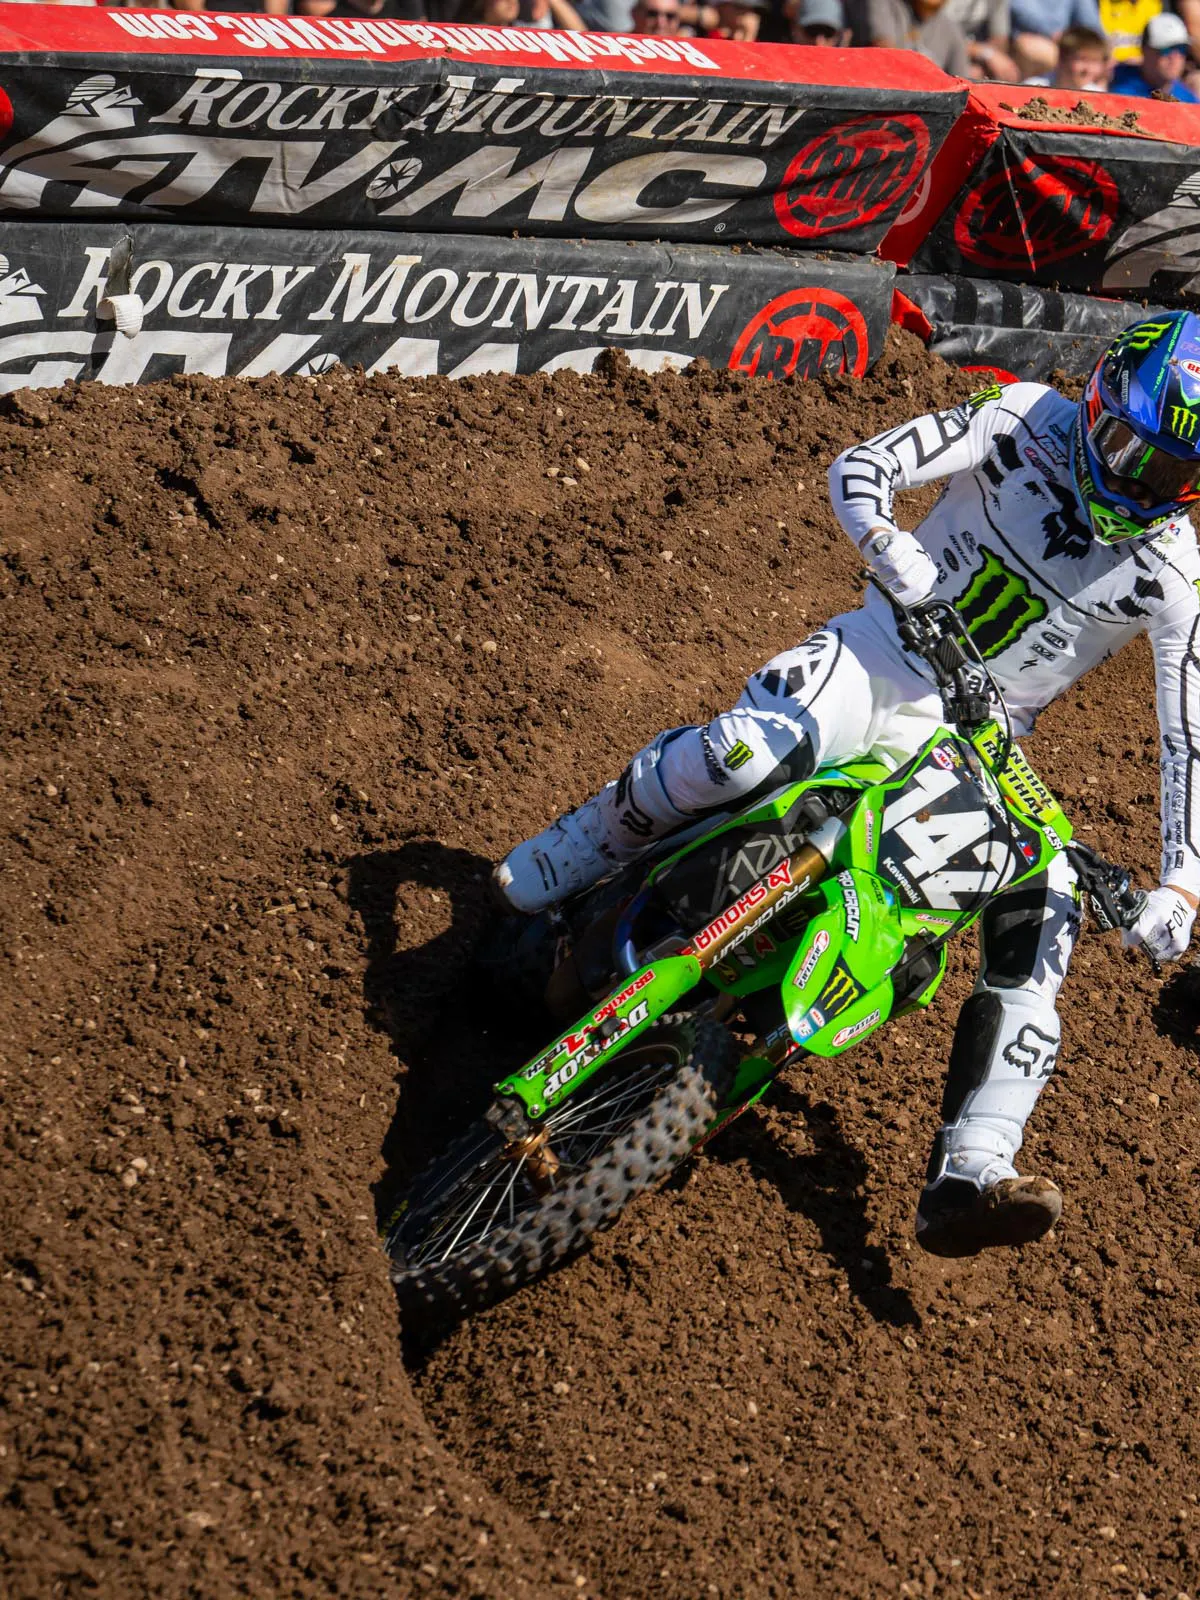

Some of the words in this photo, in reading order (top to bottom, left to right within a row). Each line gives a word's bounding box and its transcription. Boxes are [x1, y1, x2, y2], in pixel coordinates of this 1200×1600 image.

[111, 11, 721, 69] RockyMountainATVMC.com
[150, 67, 418, 132] ROCKY
[409, 75, 808, 147] MOUNTAIN
[307, 250, 731, 339] MOUNTAIN
[881, 765, 1017, 910] 142
[773, 875, 814, 912] PRO
[882, 856, 921, 905] Kawasaki
[694, 883, 768, 951] SHOWA
[710, 905, 774, 968] CIRCUIT
[842, 887, 861, 944] CIRCUIT
[1165, 899, 1188, 939] FOX
[594, 970, 656, 1023] BRAKING
